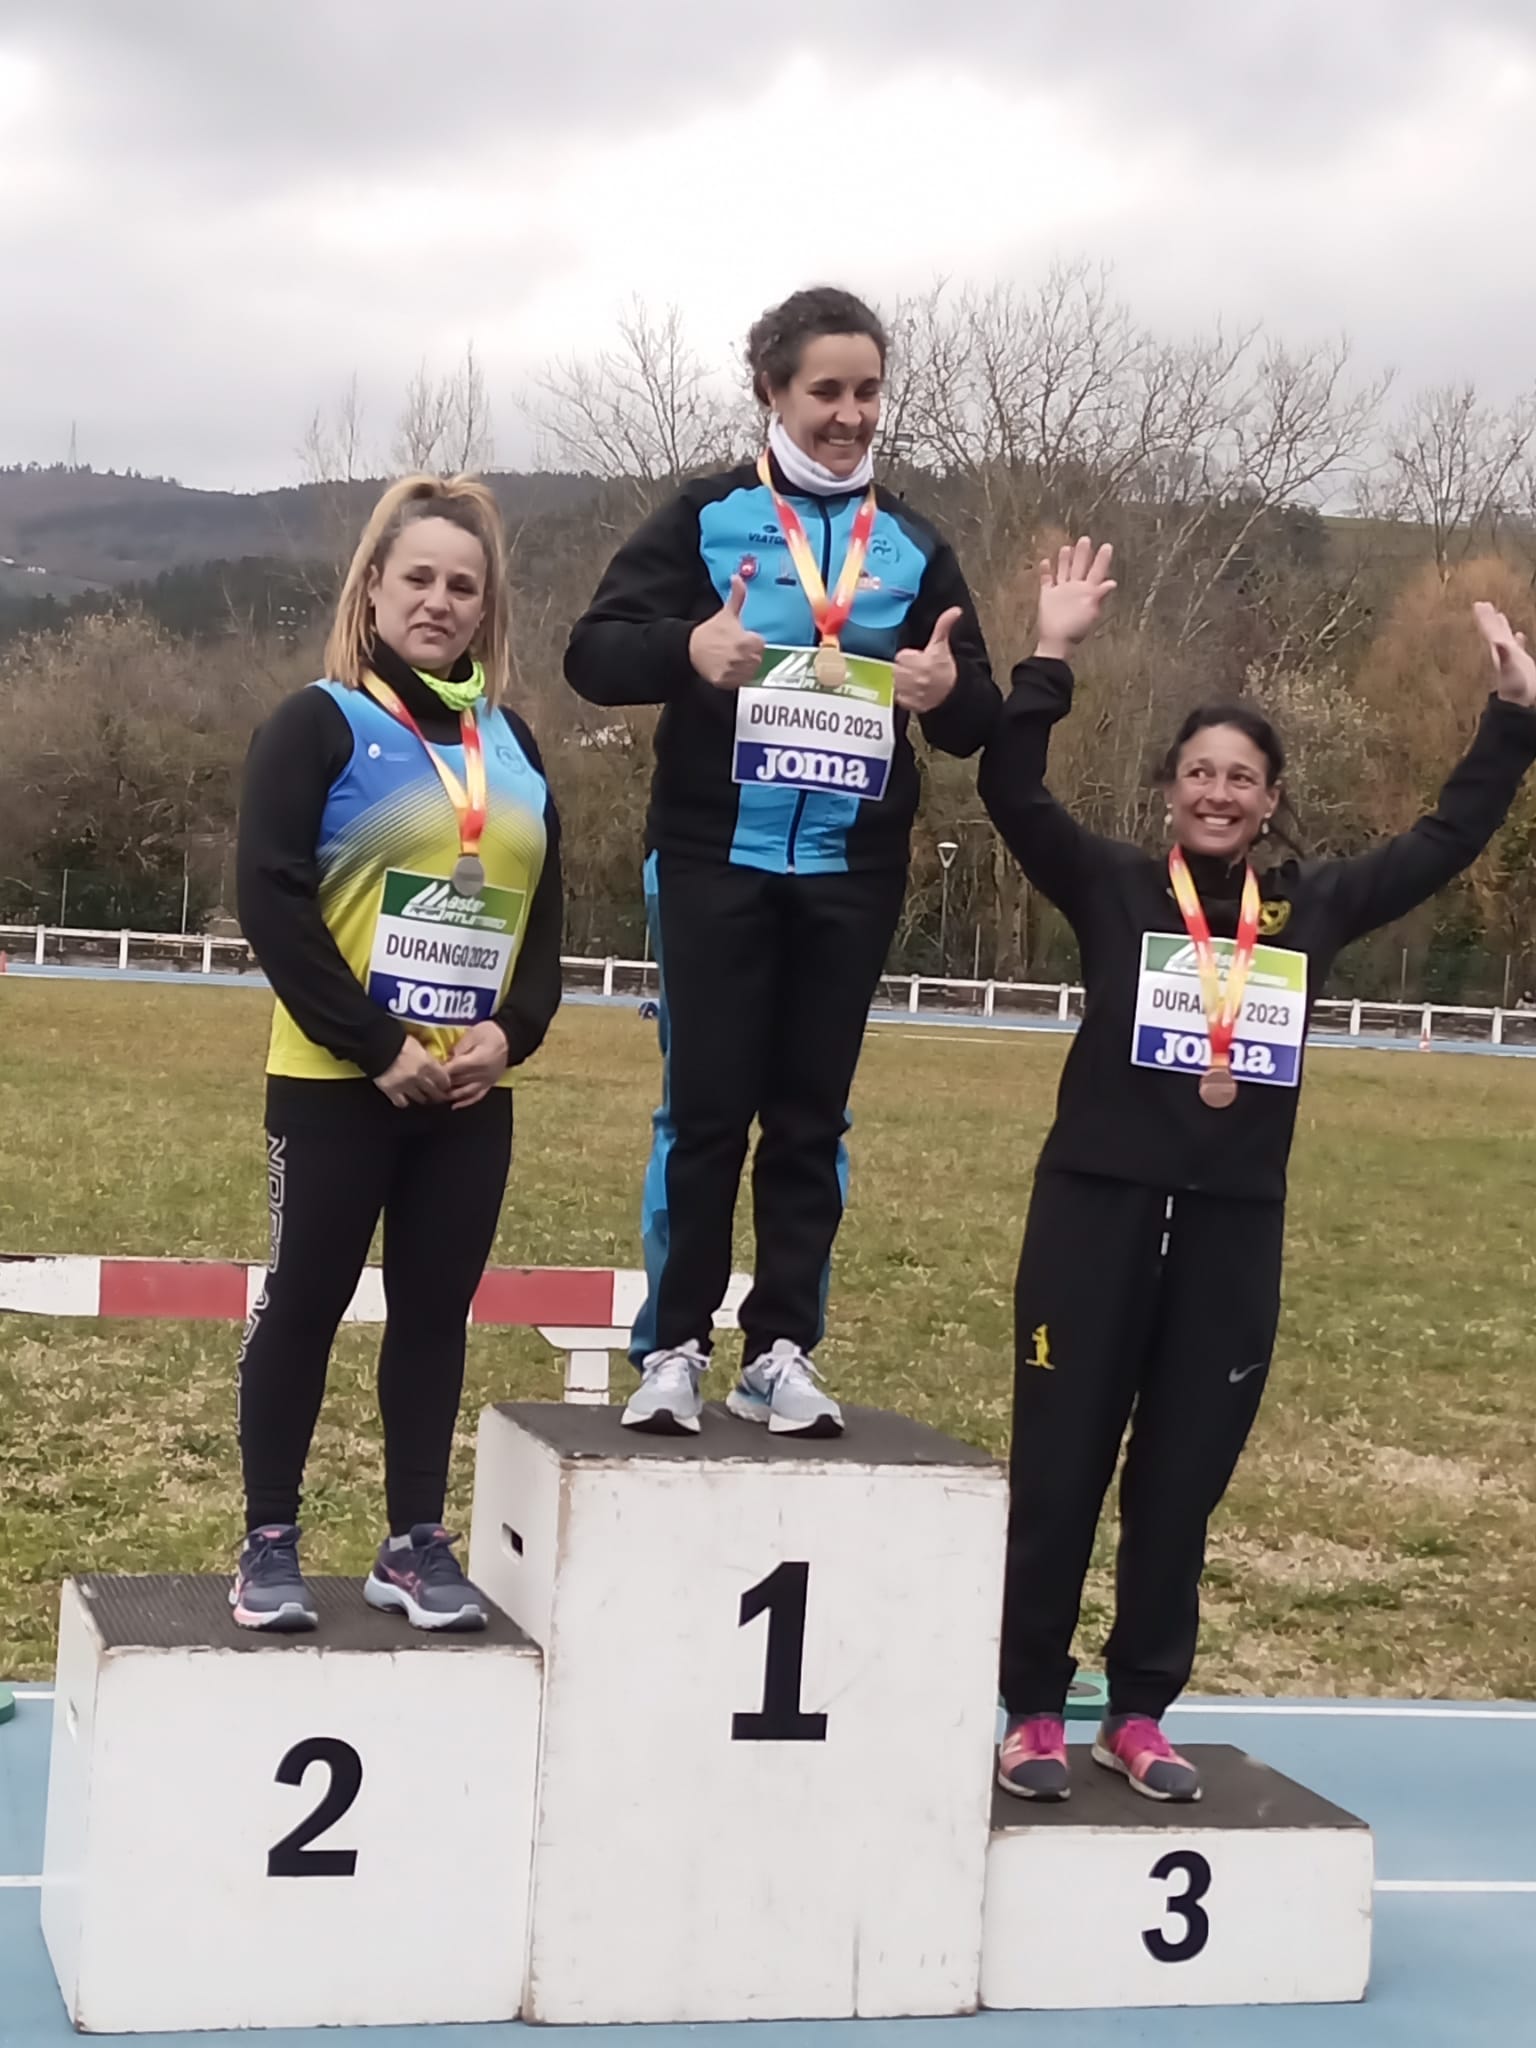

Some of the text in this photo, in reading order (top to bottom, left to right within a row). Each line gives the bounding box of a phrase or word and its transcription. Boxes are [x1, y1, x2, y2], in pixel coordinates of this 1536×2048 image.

[750, 703, 884, 741] DURANGO 2023
[1245, 1001, 1291, 1026] 2023
[731, 1561, 828, 1741] 1
[267, 1737, 364, 1877] 2
[1141, 1849, 1212, 1963] 3
